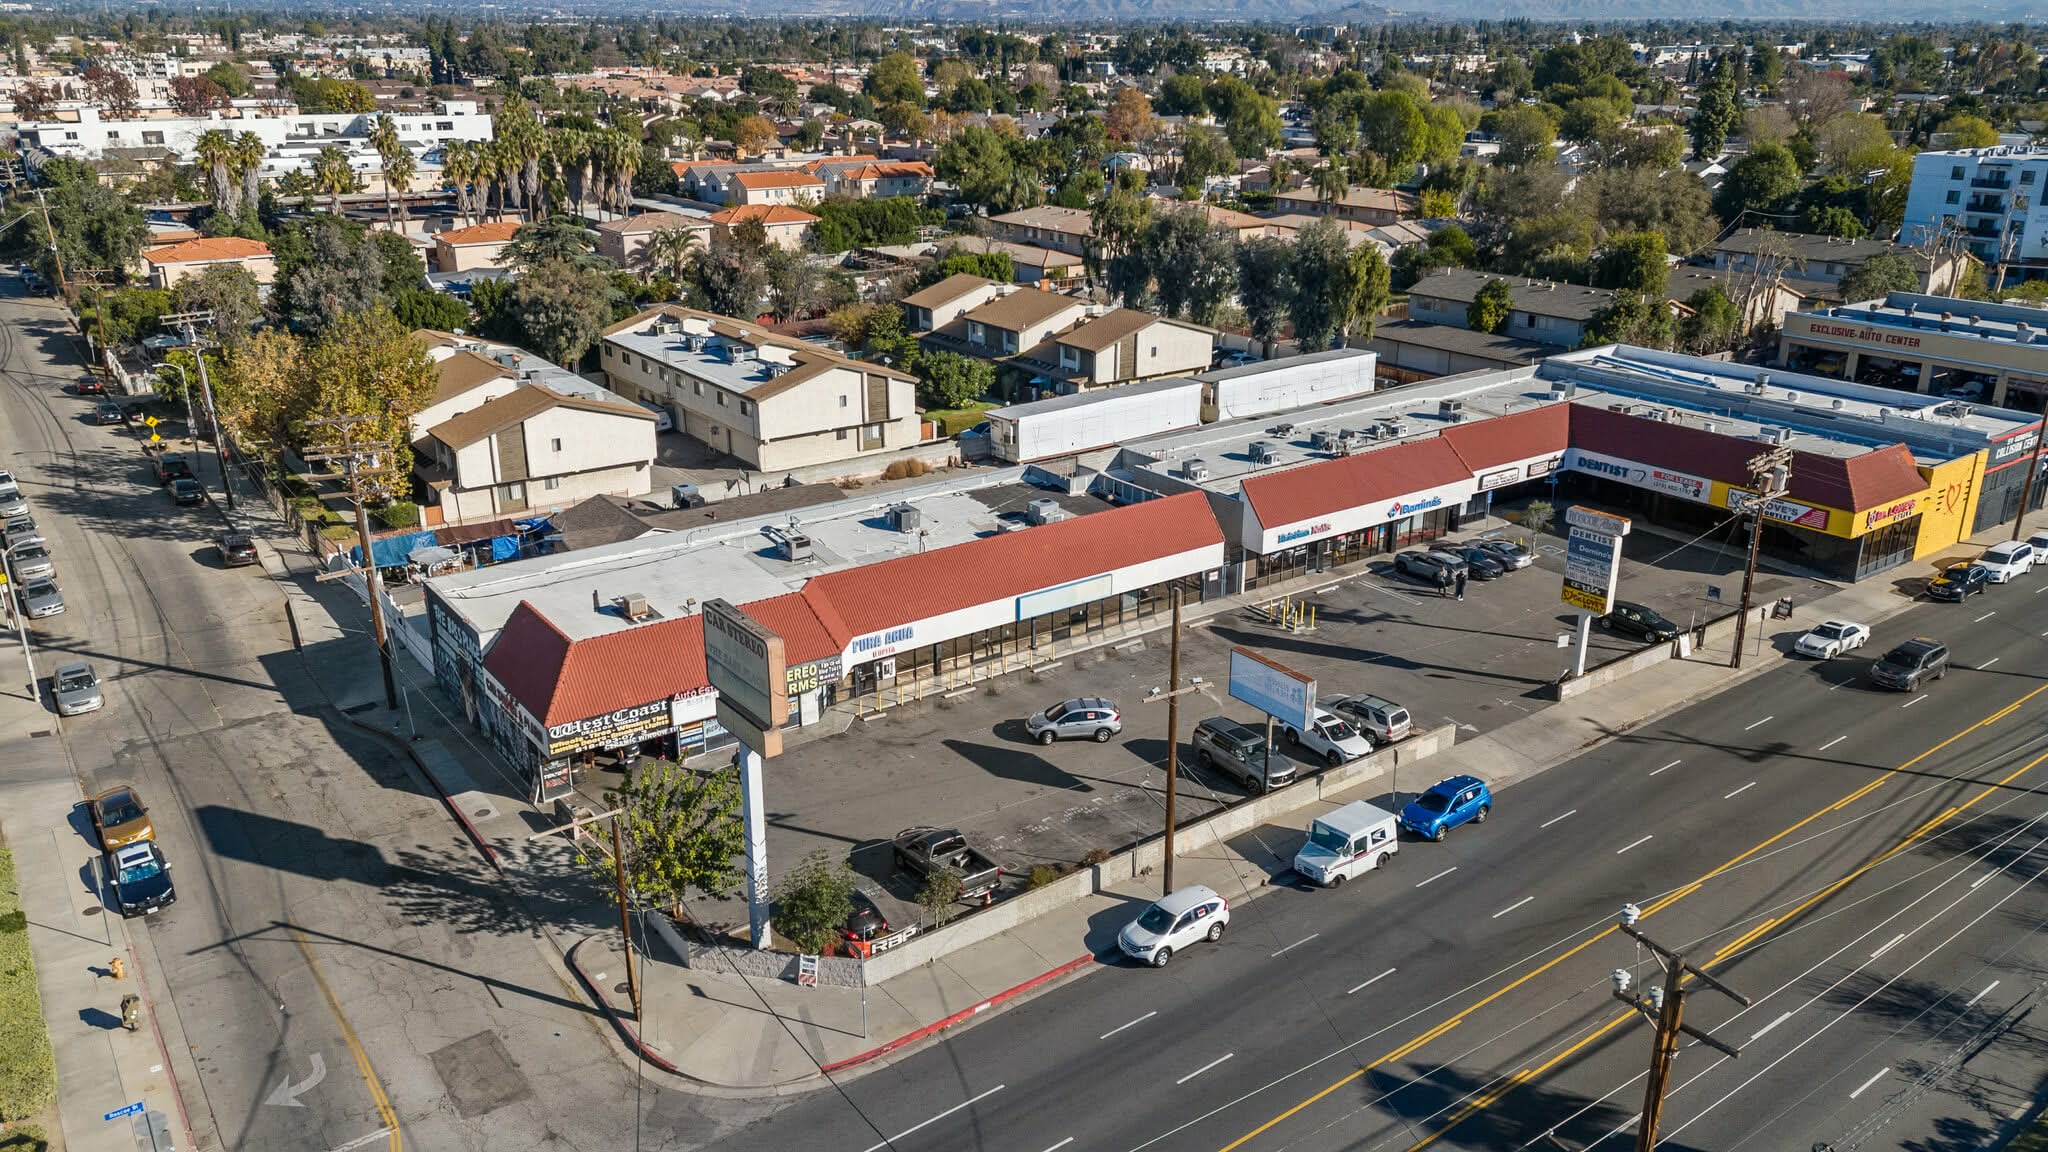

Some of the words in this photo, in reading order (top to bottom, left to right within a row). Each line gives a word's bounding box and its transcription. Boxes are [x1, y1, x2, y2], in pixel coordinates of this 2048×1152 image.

[1859, 330, 1882, 341] AUTO
[1886, 334, 1920, 347] CENTER
[2023, 435, 2039, 449] CENT
[1578, 456, 1629, 478] DENTIST
[1767, 503, 1798, 516] OVE'S
[1572, 528, 1613, 545] DENTIST
[1579, 544, 1611, 559] Domino's
[706, 610, 726, 634] CAR
[727, 623, 764, 659] STEREO
[852, 634, 882, 654] PURA
[884, 626, 913, 645] AGUA
[786, 664, 817, 682] EREO
[788, 678, 818, 695] RMS
[674, 690, 697, 701] Auto
[549, 715, 611, 738] West
[612, 700, 668, 721] Coast
[871, 927, 918, 954] RBP
